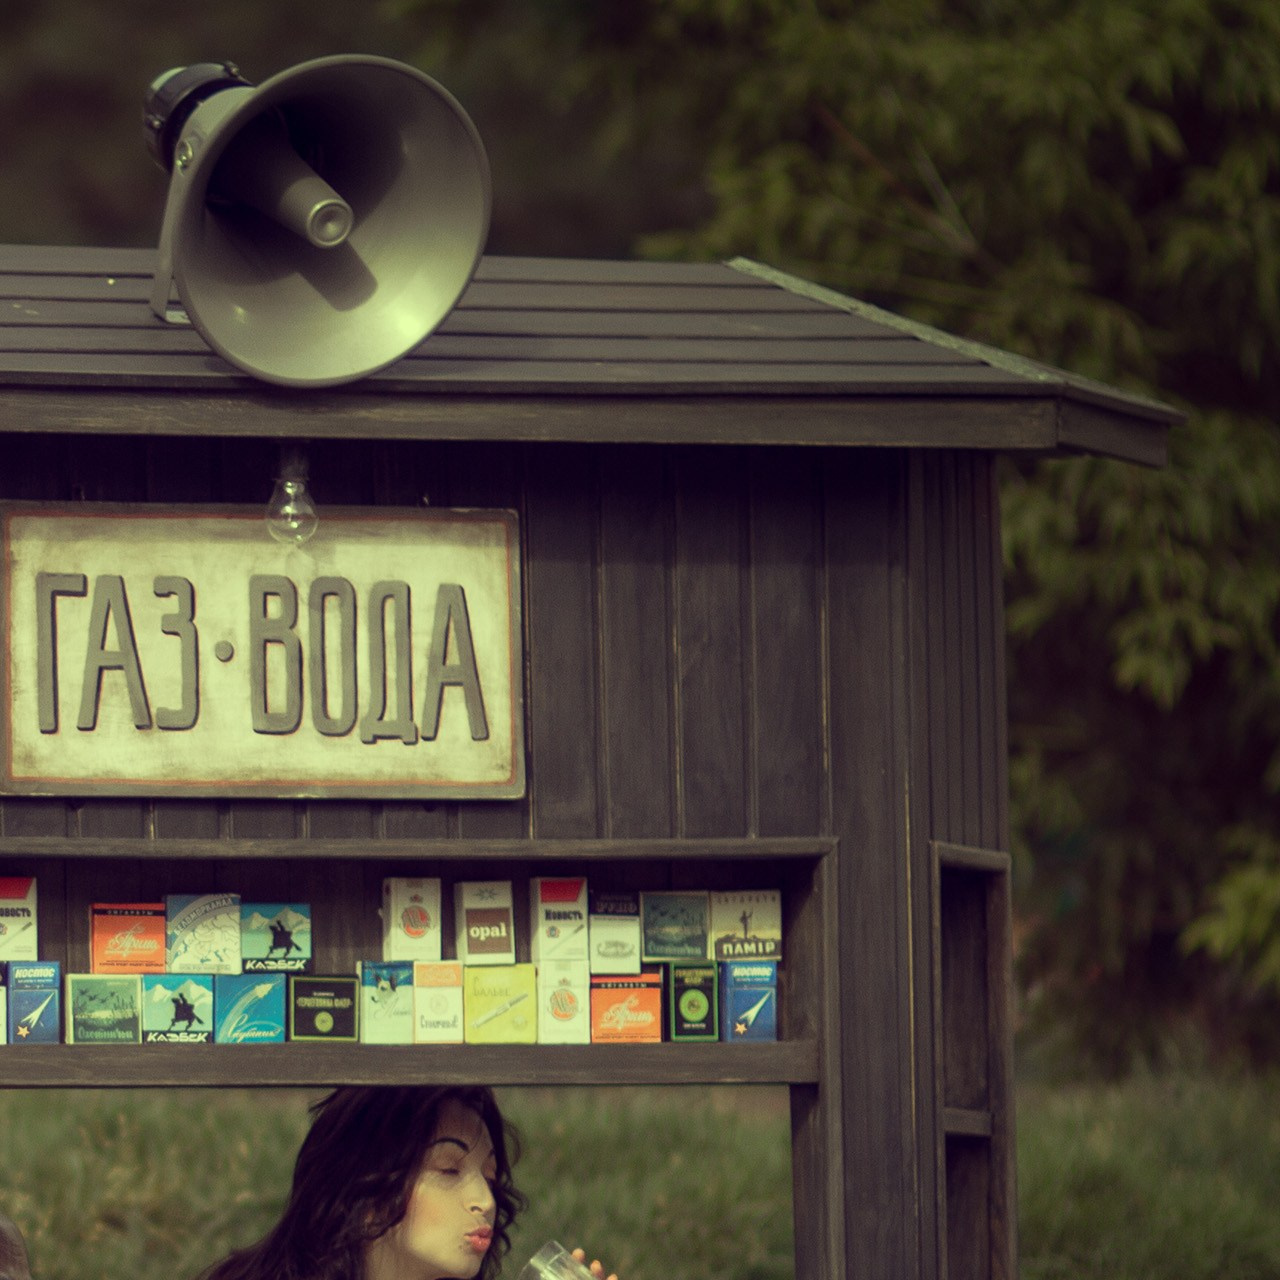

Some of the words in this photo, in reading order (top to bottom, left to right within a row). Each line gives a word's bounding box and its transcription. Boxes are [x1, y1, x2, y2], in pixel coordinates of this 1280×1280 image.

[35, 571, 201, 735] ГАЗ
[247, 573, 490, 745] ВОДА
[470, 922, 507, 941] opal
[245, 960, 307, 970] КАЗБЕК
[14, 967, 55, 978] КОСМОС
[146, 1032, 209, 1042] КАЗБЕК
